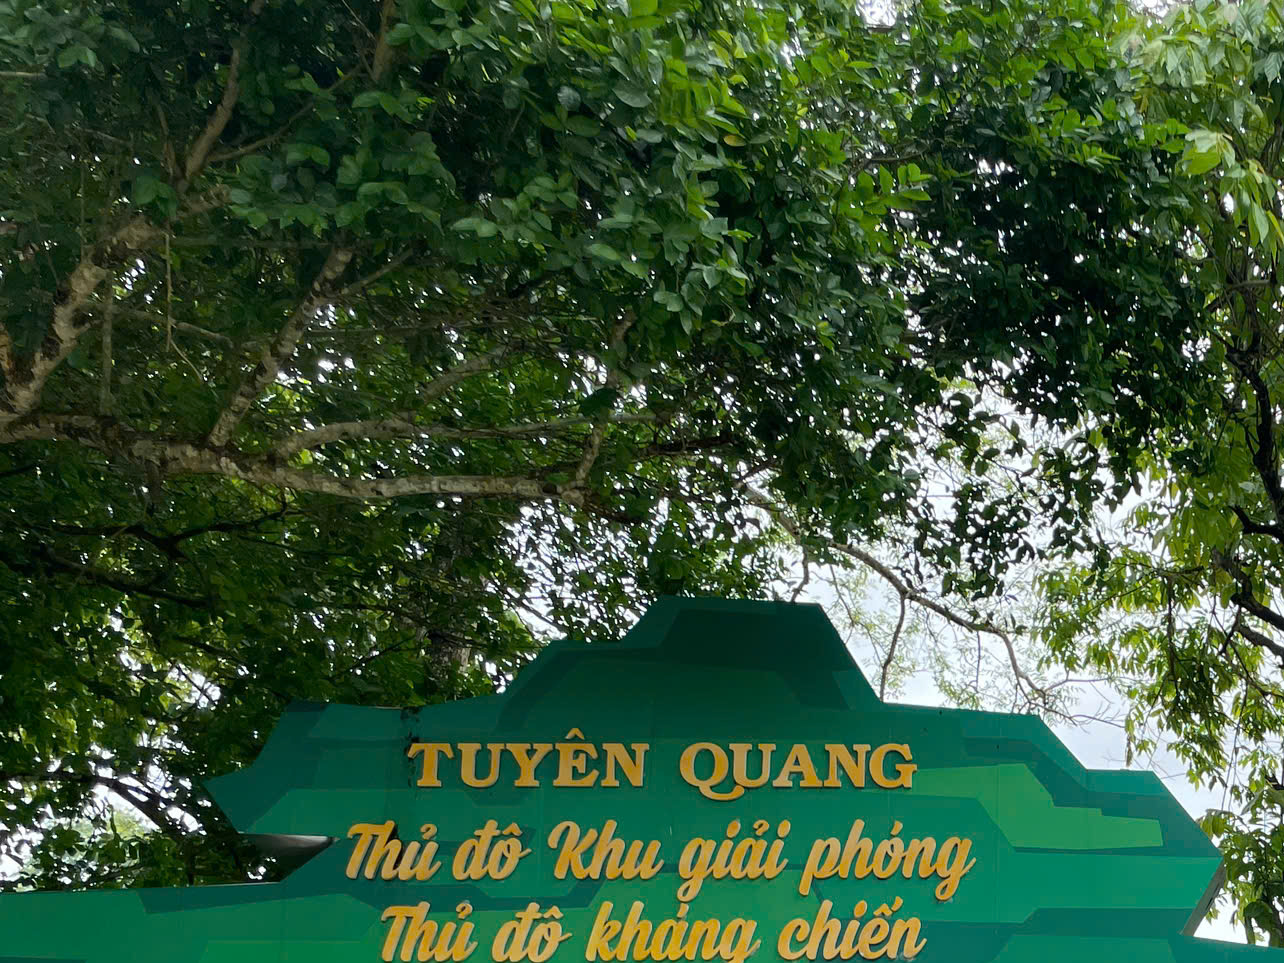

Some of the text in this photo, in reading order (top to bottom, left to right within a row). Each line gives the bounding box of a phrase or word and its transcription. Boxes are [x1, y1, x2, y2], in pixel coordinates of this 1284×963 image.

[408, 728, 917, 801] TUYÊN QUANG
[346, 819, 977, 902] Thủ đô Khu giải phóng
[381, 901, 478, 963] Thủ
[491, 907, 571, 963] đô
[777, 898, 928, 963] chiến
